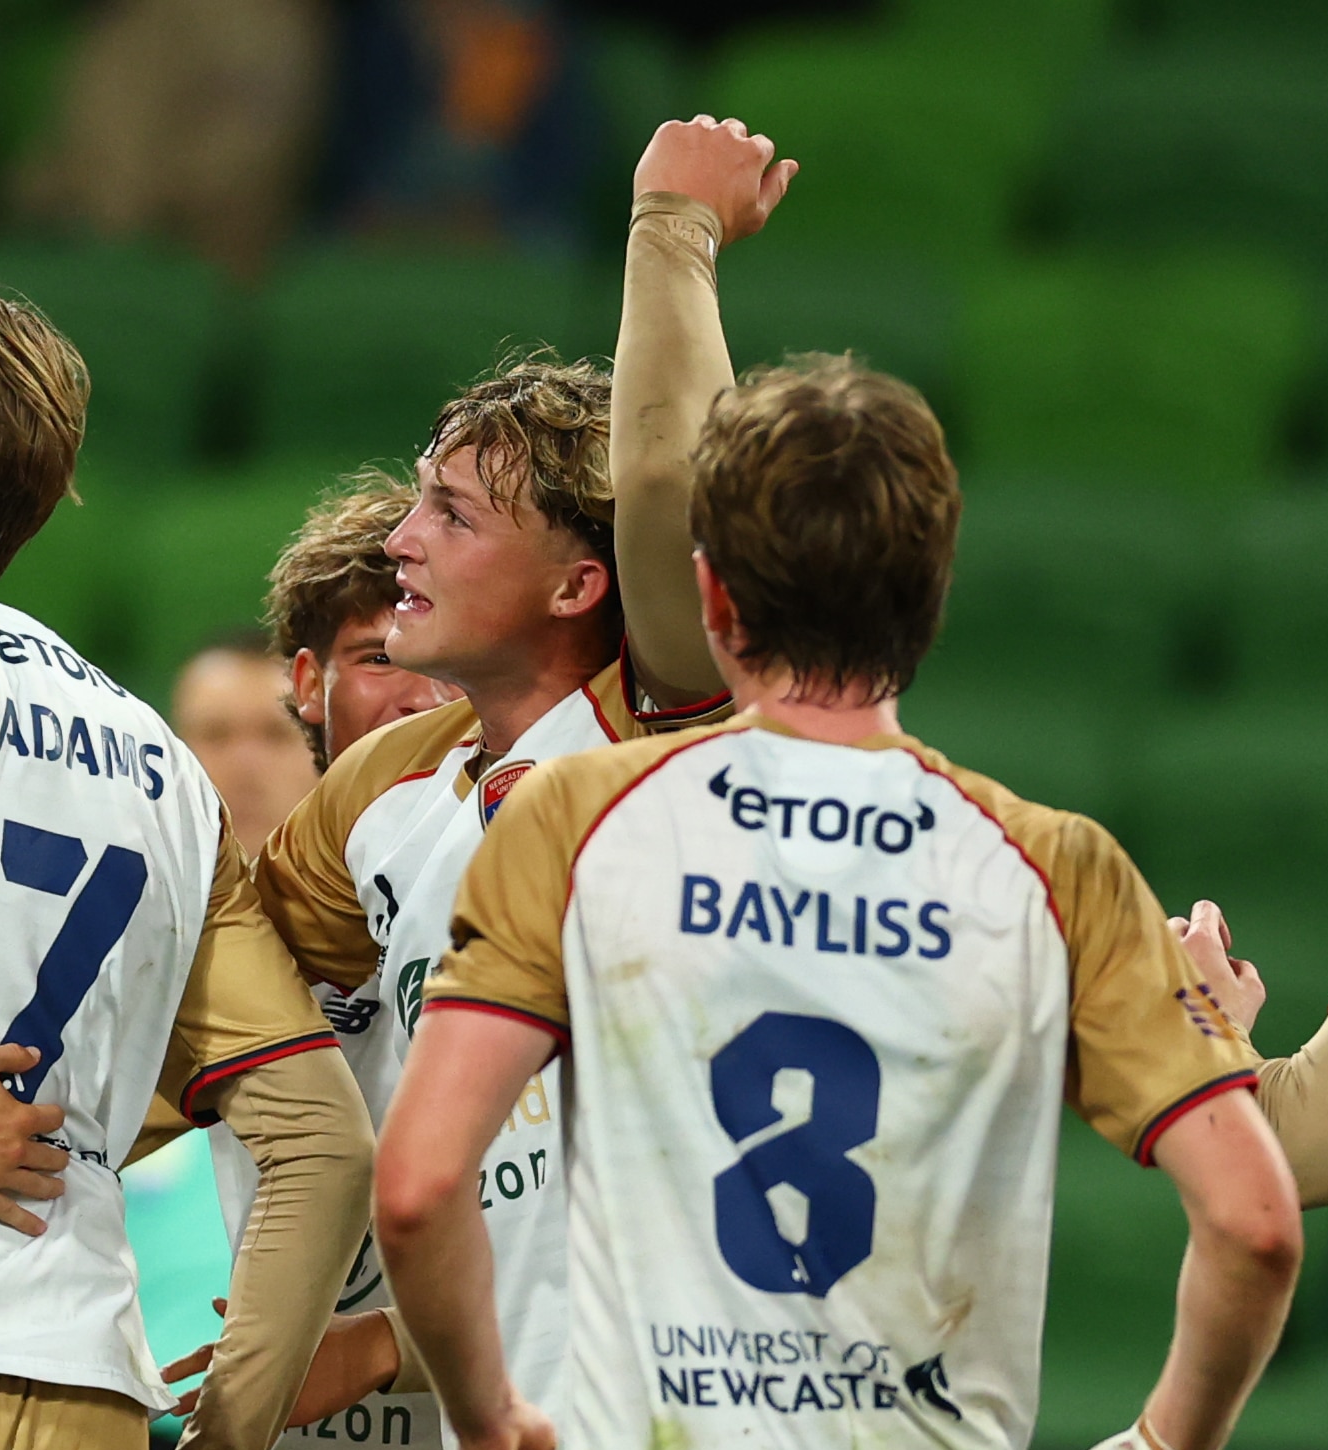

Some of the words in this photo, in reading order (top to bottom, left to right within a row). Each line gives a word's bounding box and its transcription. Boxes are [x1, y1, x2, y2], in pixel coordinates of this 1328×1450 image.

[0, 818, 148, 1104] 7
[680, 873, 952, 960] BAYLISS
[711, 1010, 881, 1299] 8
[658, 1365, 899, 1414] NEWCASTE
